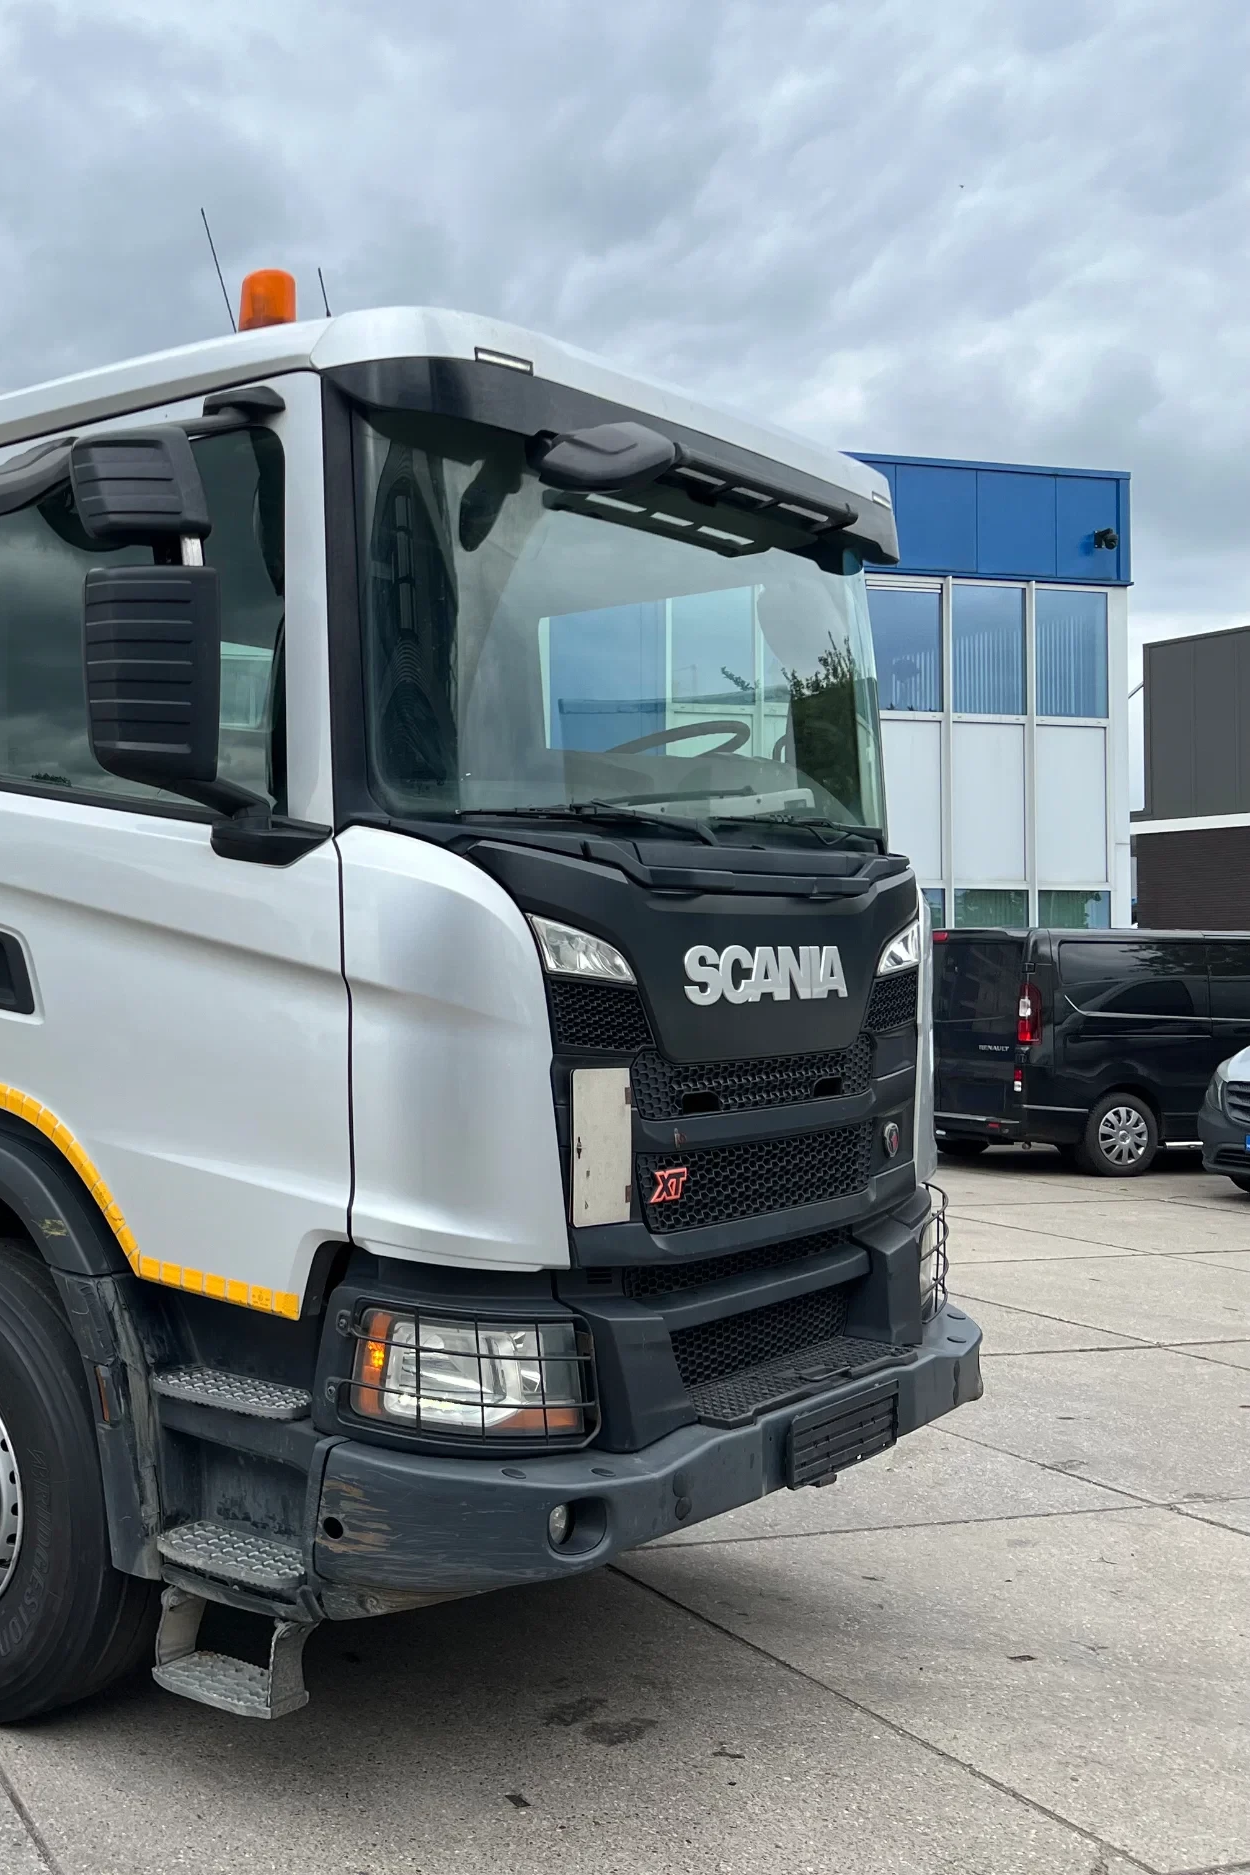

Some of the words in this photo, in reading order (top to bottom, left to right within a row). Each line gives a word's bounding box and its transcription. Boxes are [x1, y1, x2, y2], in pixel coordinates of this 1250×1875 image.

[684, 945, 848, 1006] SCANIA
[978, 1044, 1010, 1052] RENAULT
[650, 1167, 688, 1204] XT
